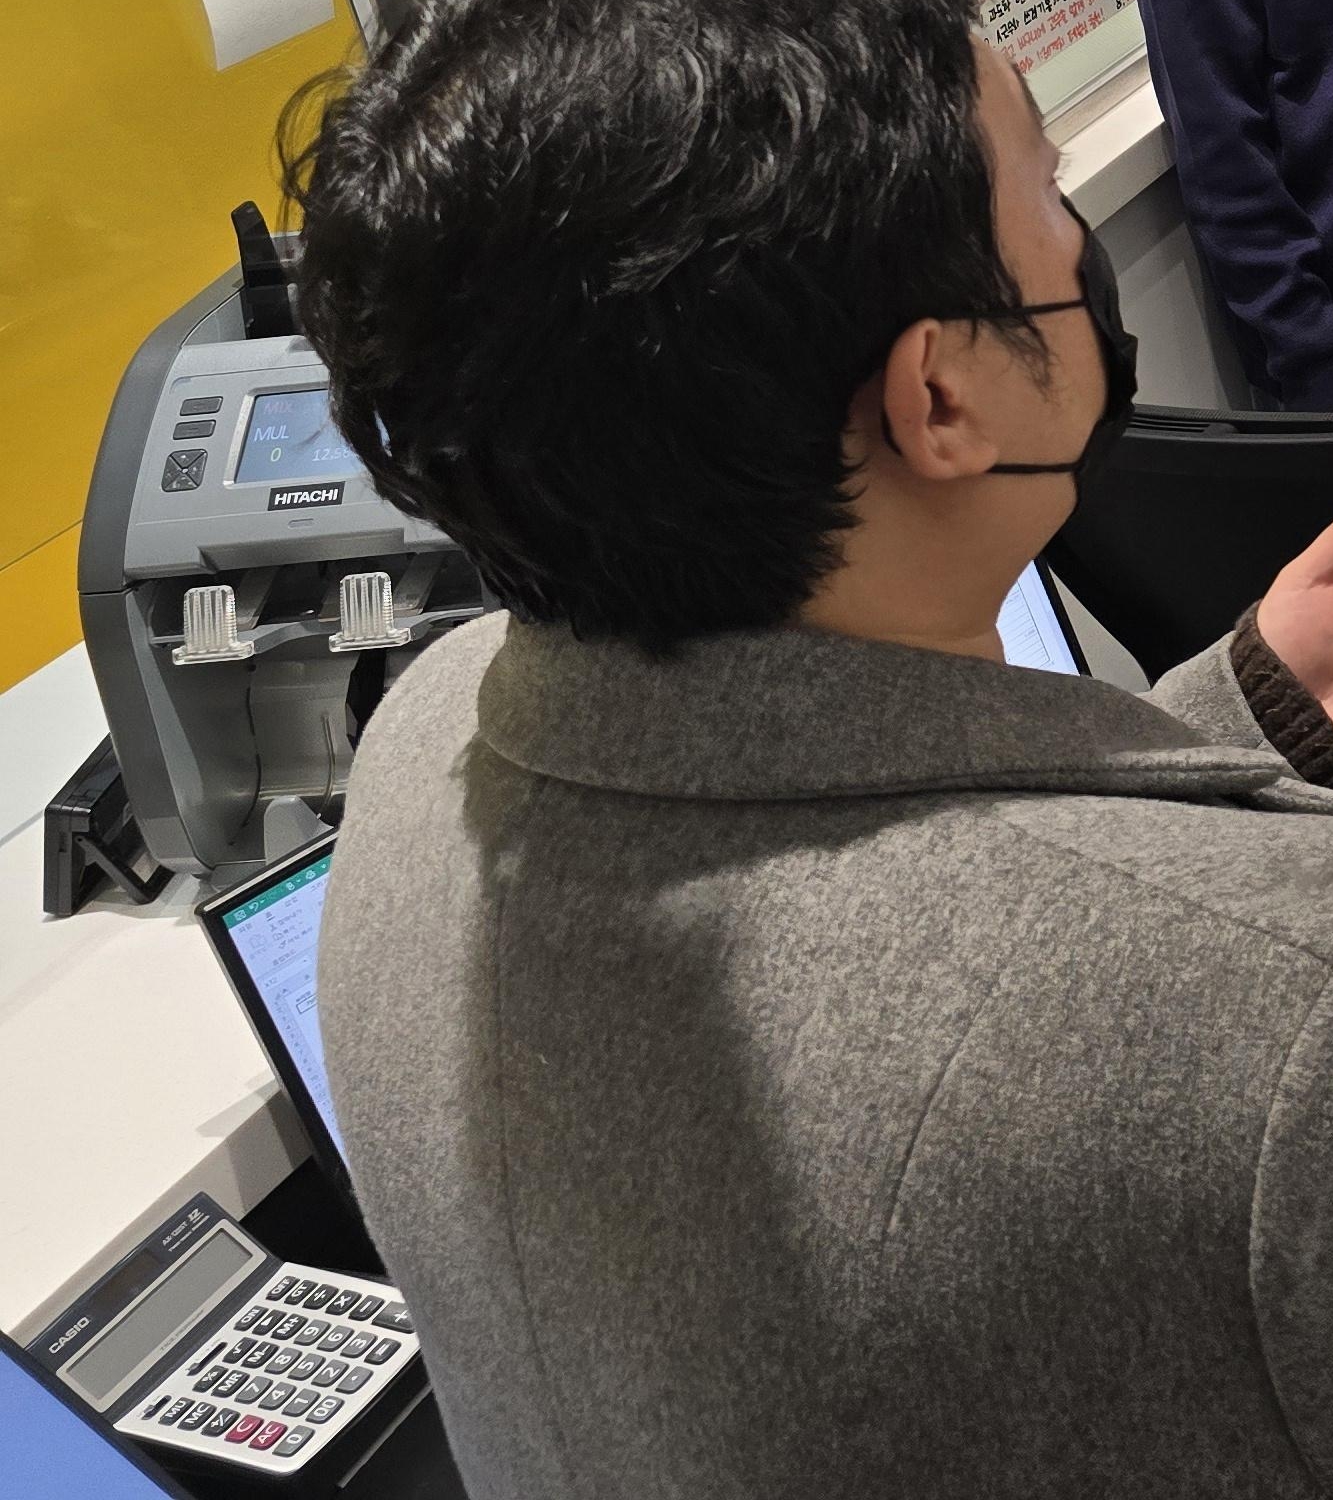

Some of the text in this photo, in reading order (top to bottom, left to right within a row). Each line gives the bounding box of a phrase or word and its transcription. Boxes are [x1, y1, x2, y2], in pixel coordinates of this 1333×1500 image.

[255, 424, 290, 442] MUL
[270, 447, 281, 462] 0
[274, 488, 339, 505] HITACHI
[272, 1278, 292, 1296] OFF
[241, 1307, 260, 1323] ON
[282, 1317, 299, 1335] M+
[48, 1316, 91, 1354] CASIO
[220, 1373, 243, 1392] MR
[167, 1400, 186, 1418] MU
[187, 1404, 210, 1424] MC
[236, 1421, 254, 1433] C
[259, 1425, 279, 1444] AC
